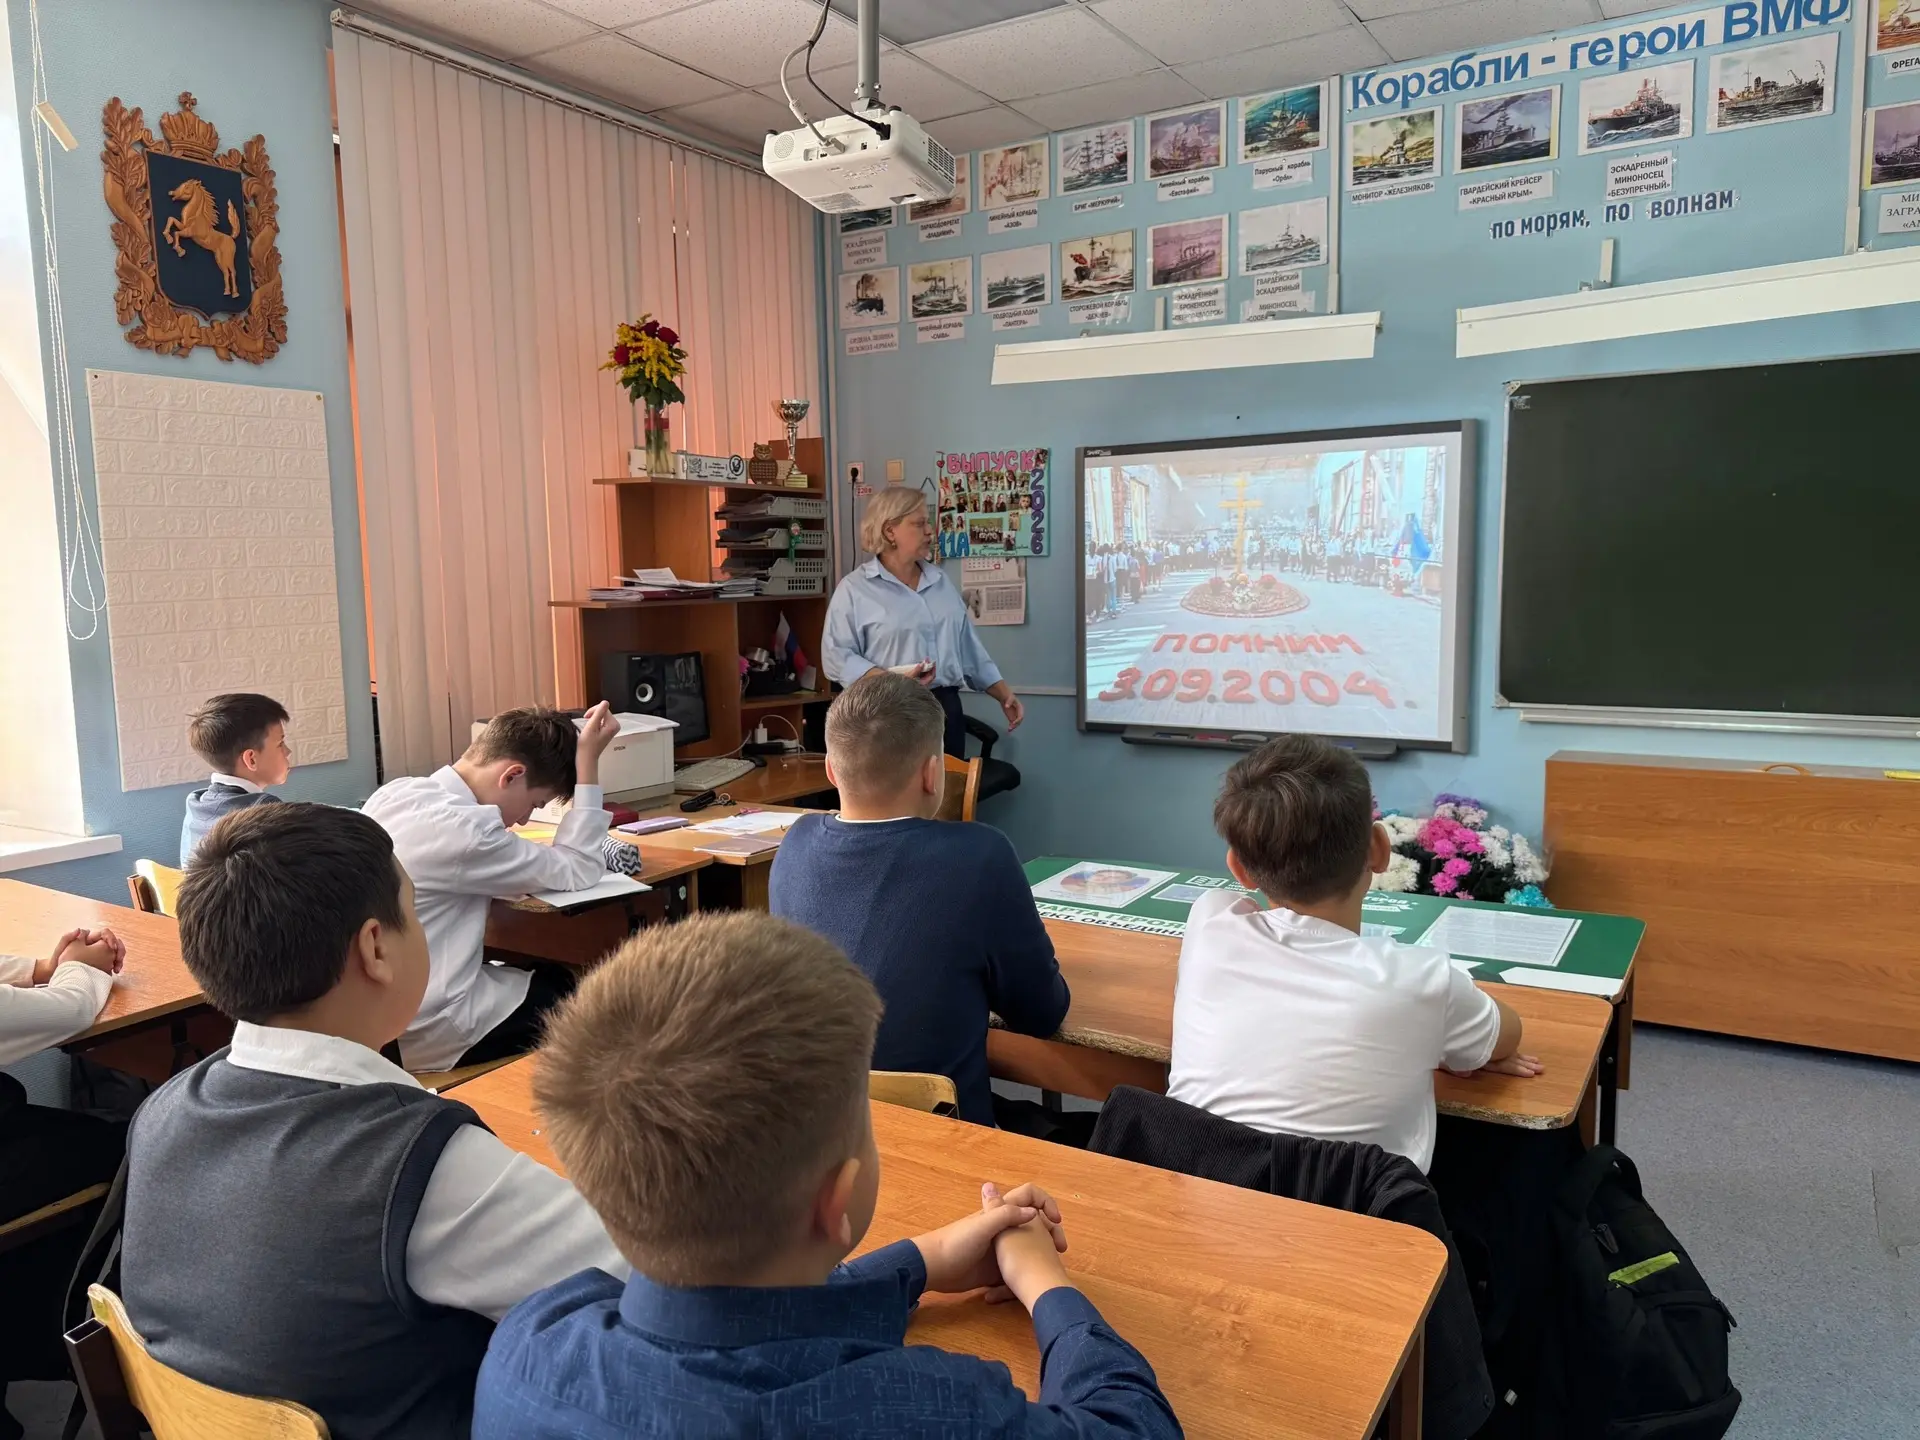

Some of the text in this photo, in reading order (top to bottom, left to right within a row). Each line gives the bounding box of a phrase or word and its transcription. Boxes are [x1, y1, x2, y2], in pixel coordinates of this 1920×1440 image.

[1352, 0, 1849, 109] Корабли - герои ВМФ
[1254, 160, 1311, 176] Парусный корабль
[1610, 156, 1668, 174] ЭСКАДРЕННЫЙ
[1158, 175, 1211, 189] Линейный корабль
[1460, 175, 1543, 196] ГВАРДЕЙСКИЙ КРЕЙСЕР
[1614, 170, 1664, 185] МИНОНОСЕЦ
[1169, 186, 1200, 198] «Евстафий»
[1351, 183, 1434, 201] МОНИТОР «ЖЕЛЕЗНЯКОВ»
[1469, 188, 1534, 205] «КРАСНЫЙ КРЫМ»
[1607, 180, 1671, 197] «БЕЗУПРЕЧНЫЙ»
[1492, 190, 1734, 239] по морям, по волнам
[1256, 273, 1299, 286] ГВАРДЕЙСКИЙ
[1255, 284, 1300, 297] ЭСКАДРЕННЫЙ
[1259, 300, 1298, 310] МИНОНОСЕЦ
[947, 450, 1037, 474] ВЫПУСК
[1030, 469, 1046, 555] 2026
[939, 531, 970, 558] 11А
[1153, 633, 1365, 656] ПОМНИМ
